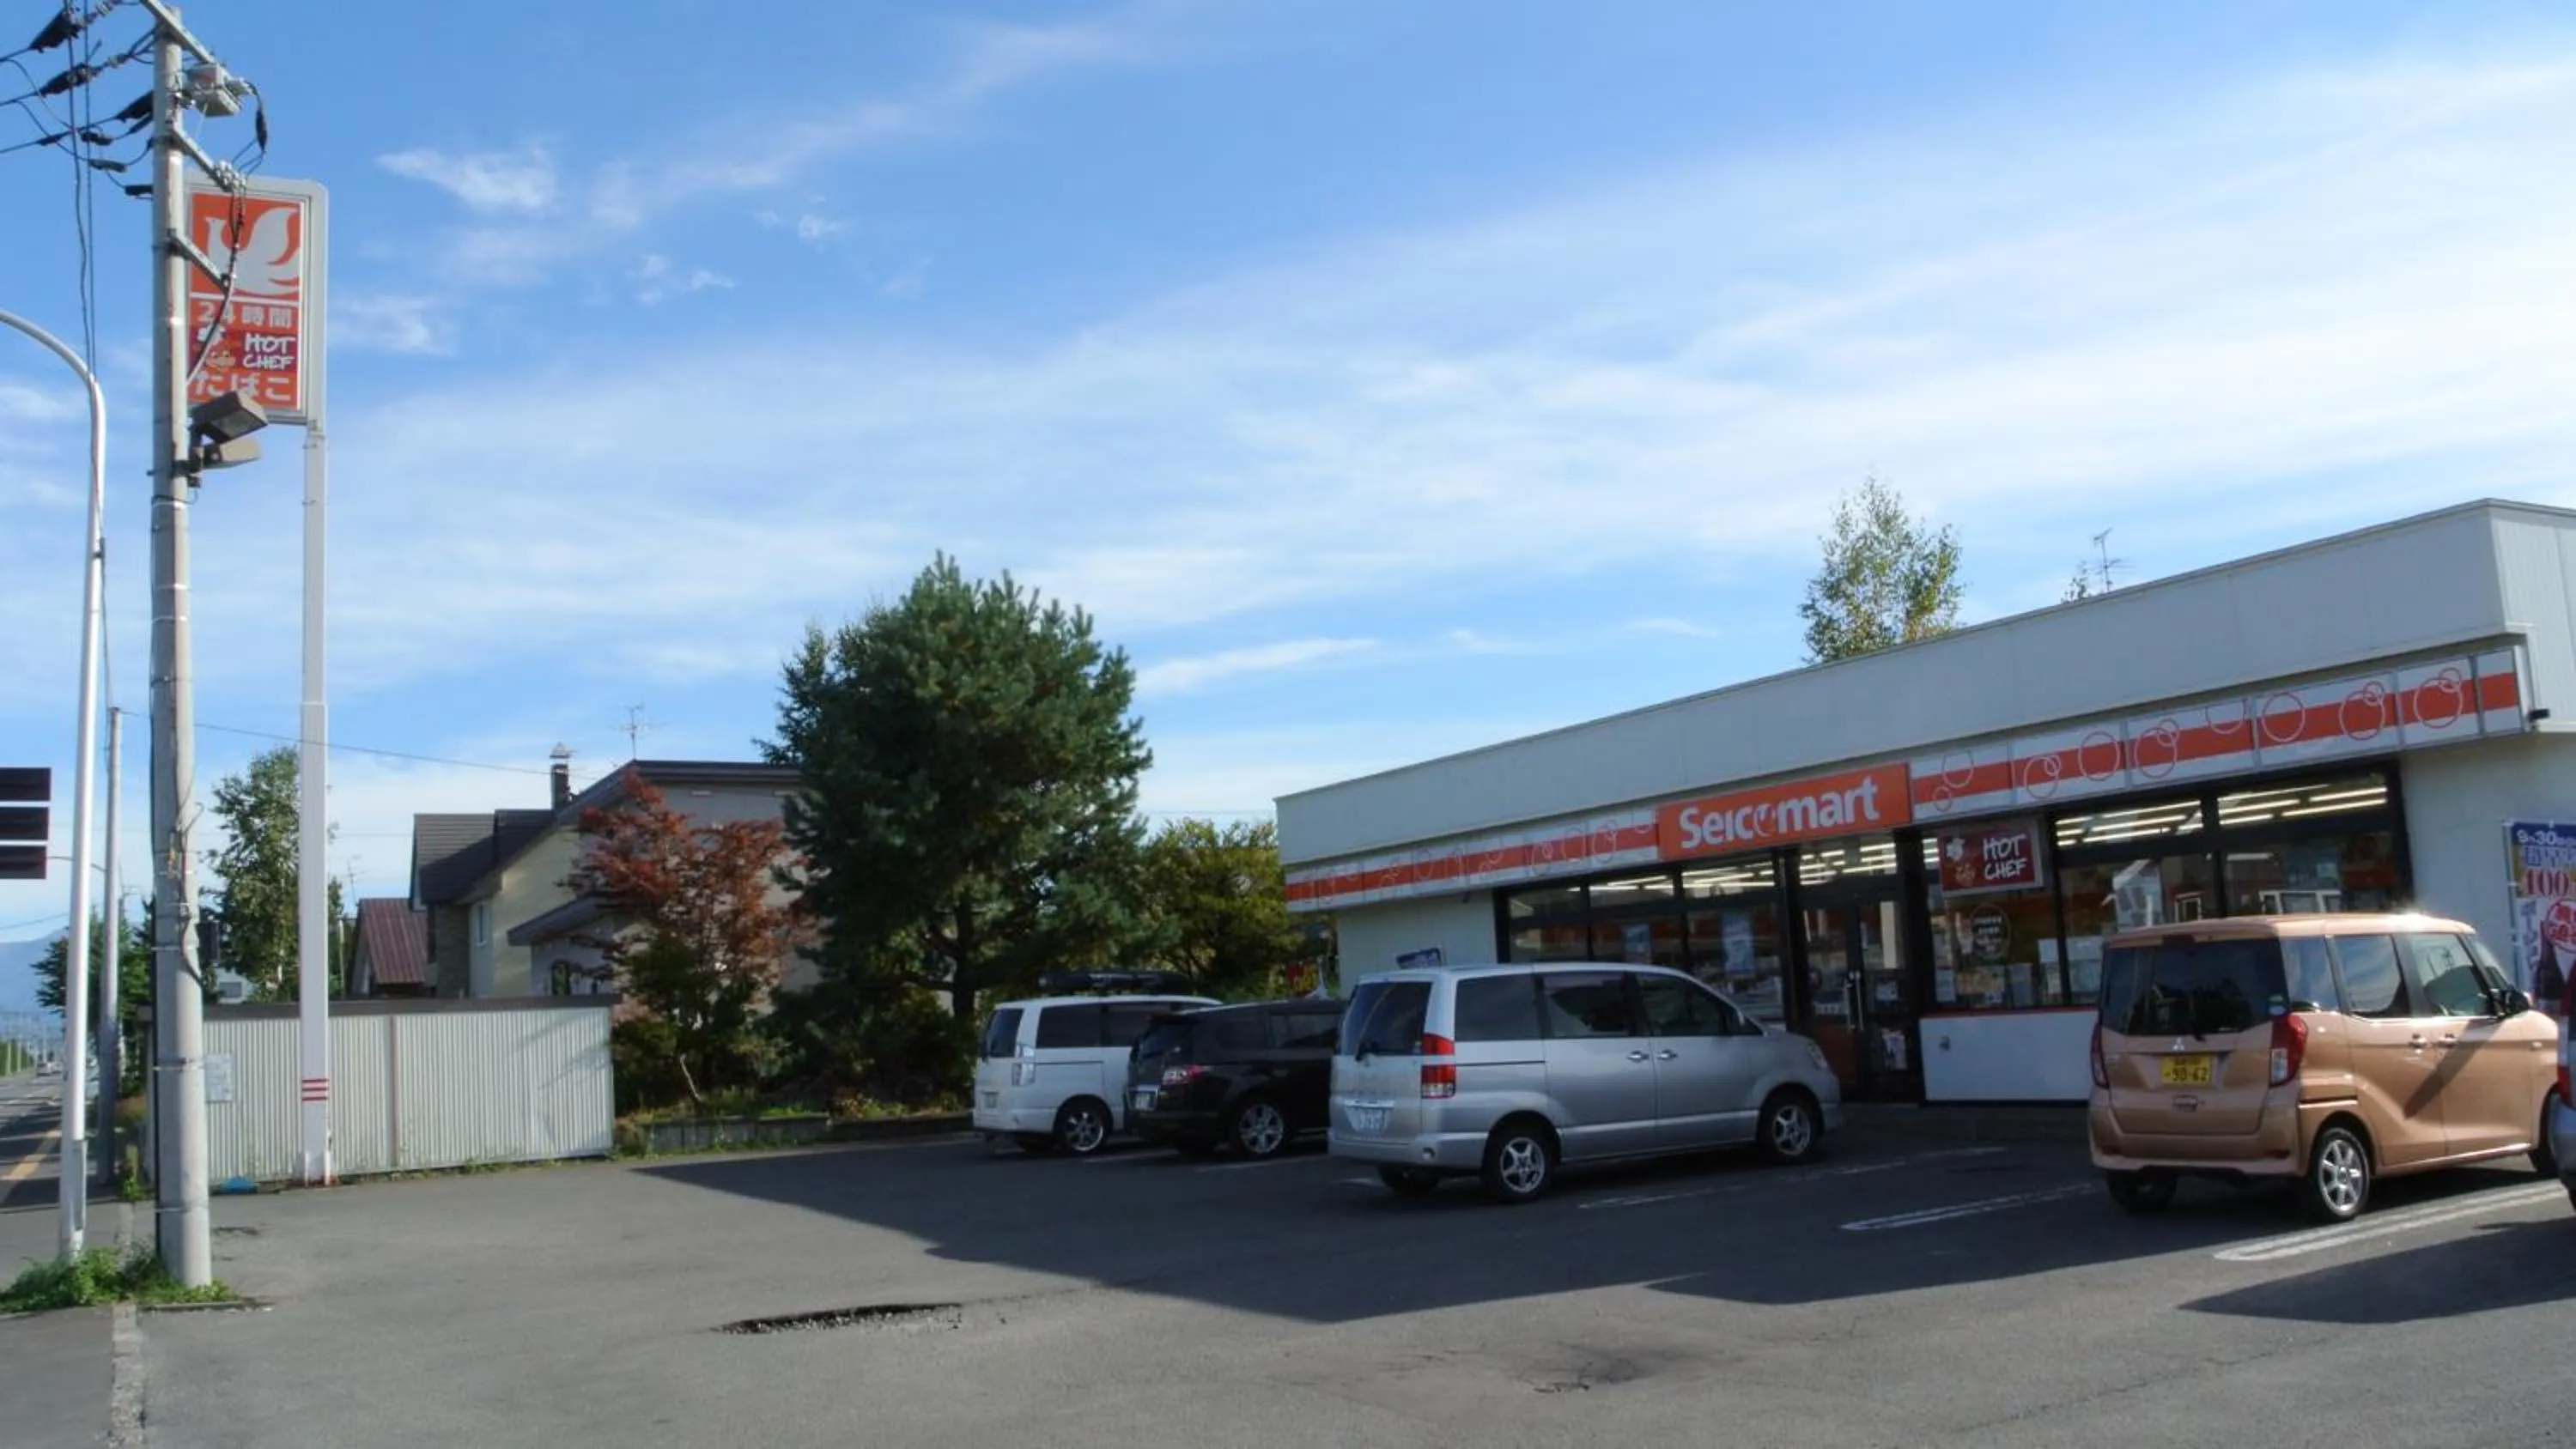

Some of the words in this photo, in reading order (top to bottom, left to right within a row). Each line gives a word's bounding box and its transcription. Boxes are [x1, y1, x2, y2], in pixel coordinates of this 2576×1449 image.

[197, 301, 291, 328] 24時間
[244, 333, 295, 353] HOT
[242, 354, 295, 370] CHEF
[195, 371, 291, 401] たばこ
[1680, 776, 1880, 849] Seicomart
[1983, 834, 2026, 860] HOT
[1984, 858, 2027, 880] CHEF
